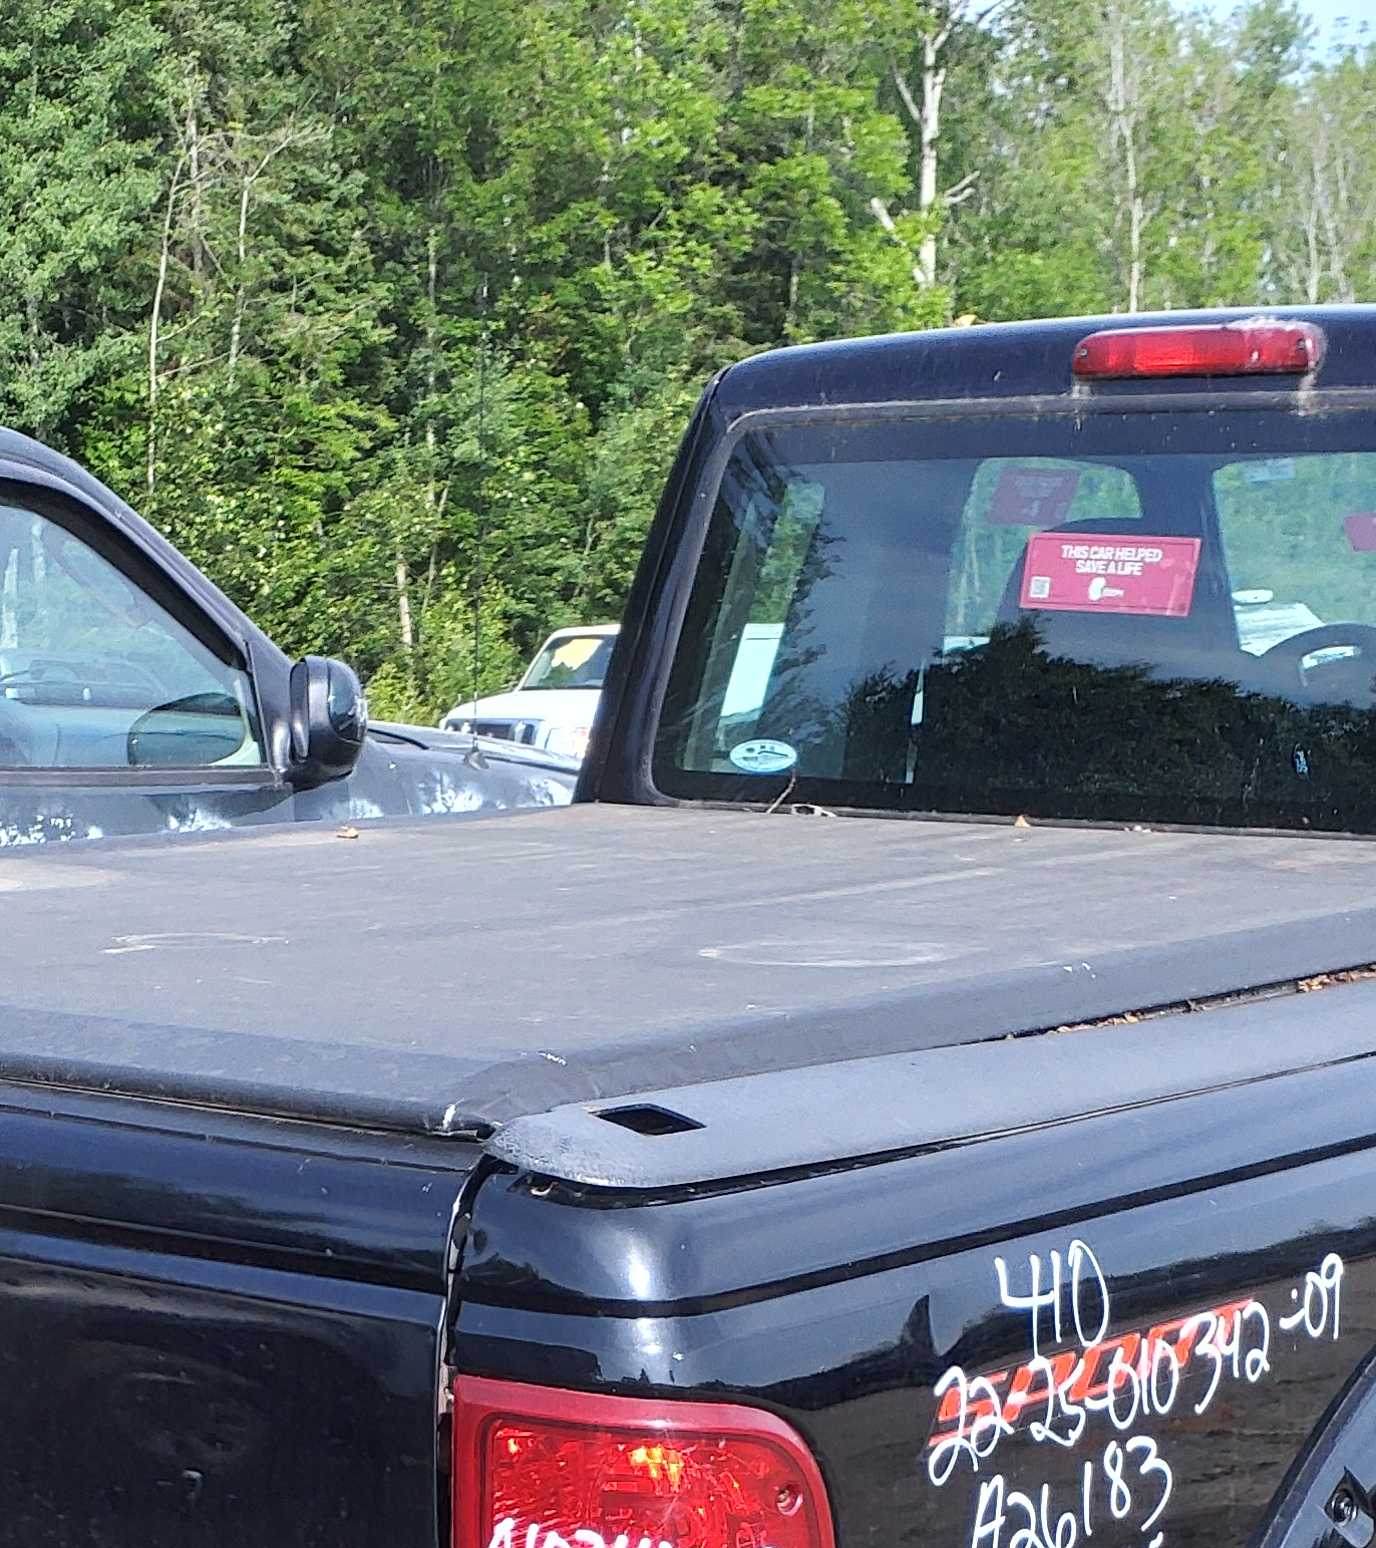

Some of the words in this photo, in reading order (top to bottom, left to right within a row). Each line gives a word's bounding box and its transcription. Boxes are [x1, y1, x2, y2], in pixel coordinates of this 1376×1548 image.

[1061, 545, 1089, 559] THIS
[1090, 546, 1114, 561] CAR
[1115, 547, 1162, 562] HELPED
[1075, 560, 1107, 574] SAVE
[1118, 562, 1143, 576] LIFE
[994, 1239, 1110, 1357] 410
